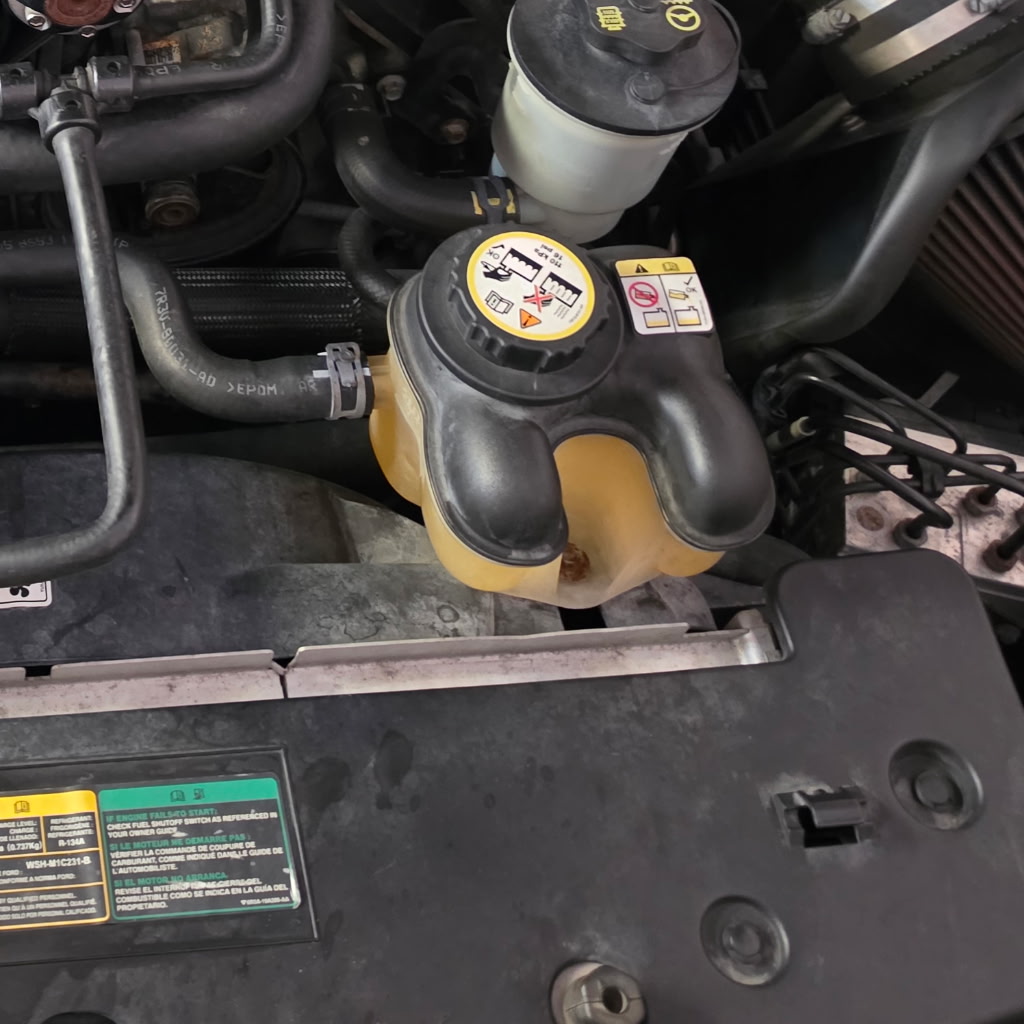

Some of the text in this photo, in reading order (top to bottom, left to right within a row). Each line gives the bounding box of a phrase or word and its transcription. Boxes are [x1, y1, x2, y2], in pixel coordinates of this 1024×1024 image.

[485, 247, 501, 260] OK
[106, 822, 131, 831] CHECK
[107, 830, 128, 839] YOUR
[57, 837, 86, 847] R-134A
[197, 844, 208, 852] DE
[245, 841, 256, 849] DE
